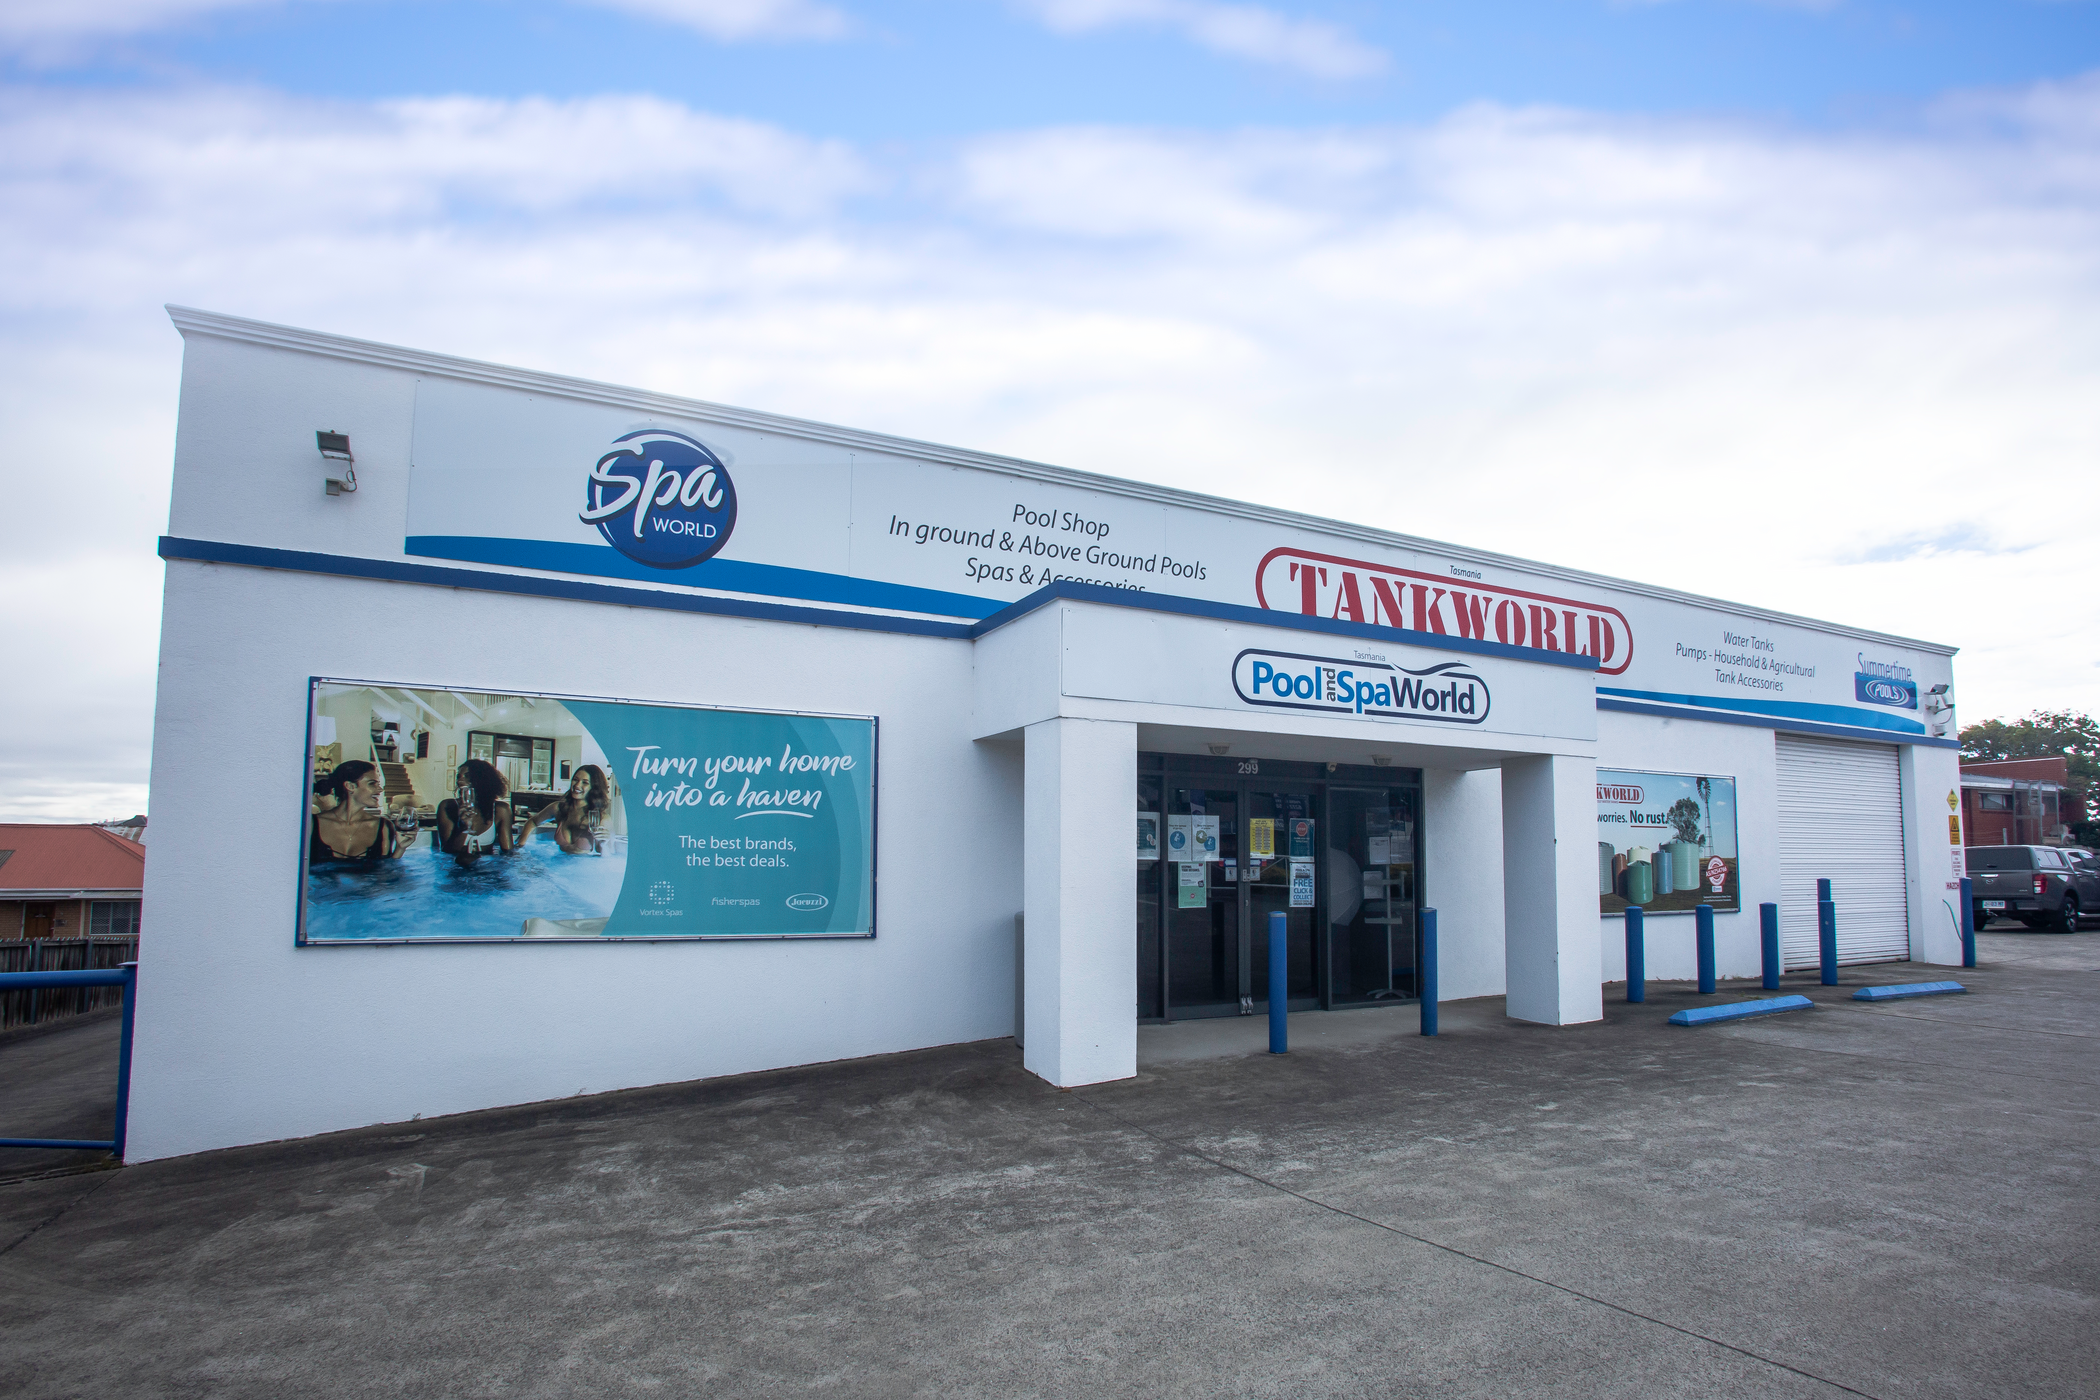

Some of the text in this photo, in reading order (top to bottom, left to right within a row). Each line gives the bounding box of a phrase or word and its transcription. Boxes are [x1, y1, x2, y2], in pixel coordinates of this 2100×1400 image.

[579, 442, 724, 538] Spa
[653, 517, 717, 539] WORLD
[1012, 503, 1110, 541] Pool Shop
[889, 514, 910, 537] In
[915, 523, 995, 549] ground
[998, 531, 1015, 552] &
[1018, 535, 1081, 562] Above
[1086, 545, 1157, 573] Ground
[1160, 556, 1207, 581] Pools
[965, 557, 1014, 583] Spas
[1018, 564, 1035, 585] &
[1449, 565, 1482, 579] Tasmania
[1289, 562, 1615, 663] TANKWORLD
[1723, 631, 1774, 652] Water Tanks
[1353, 650, 1386, 662] Tasmania
[1675, 642, 1707, 662] Pumps
[1713, 649, 1760, 669] Household
[1761, 657, 1768, 670] &
[1768, 659, 1816, 678] Agricultural
[1857, 652, 1912, 683] Summertime
[1252, 660, 1322, 701] Pool
[1715, 668, 1784, 692] Tank Accessories
[1874, 683, 1900, 700] POOLS
[625, 743, 857, 790] Turn your home
[1237, 761, 1259, 775] 299
[644, 777, 822, 812] into a haven
[1629, 809, 1644, 824] No
[1646, 812, 1668, 825] rust.
[678, 835, 797, 852] The best brands,
[686, 853, 790, 868] the best deals.
[1293, 878, 1313, 887] FREE
[665, 909, 684, 918] Spas
[711, 897, 761, 908] fisherspas
